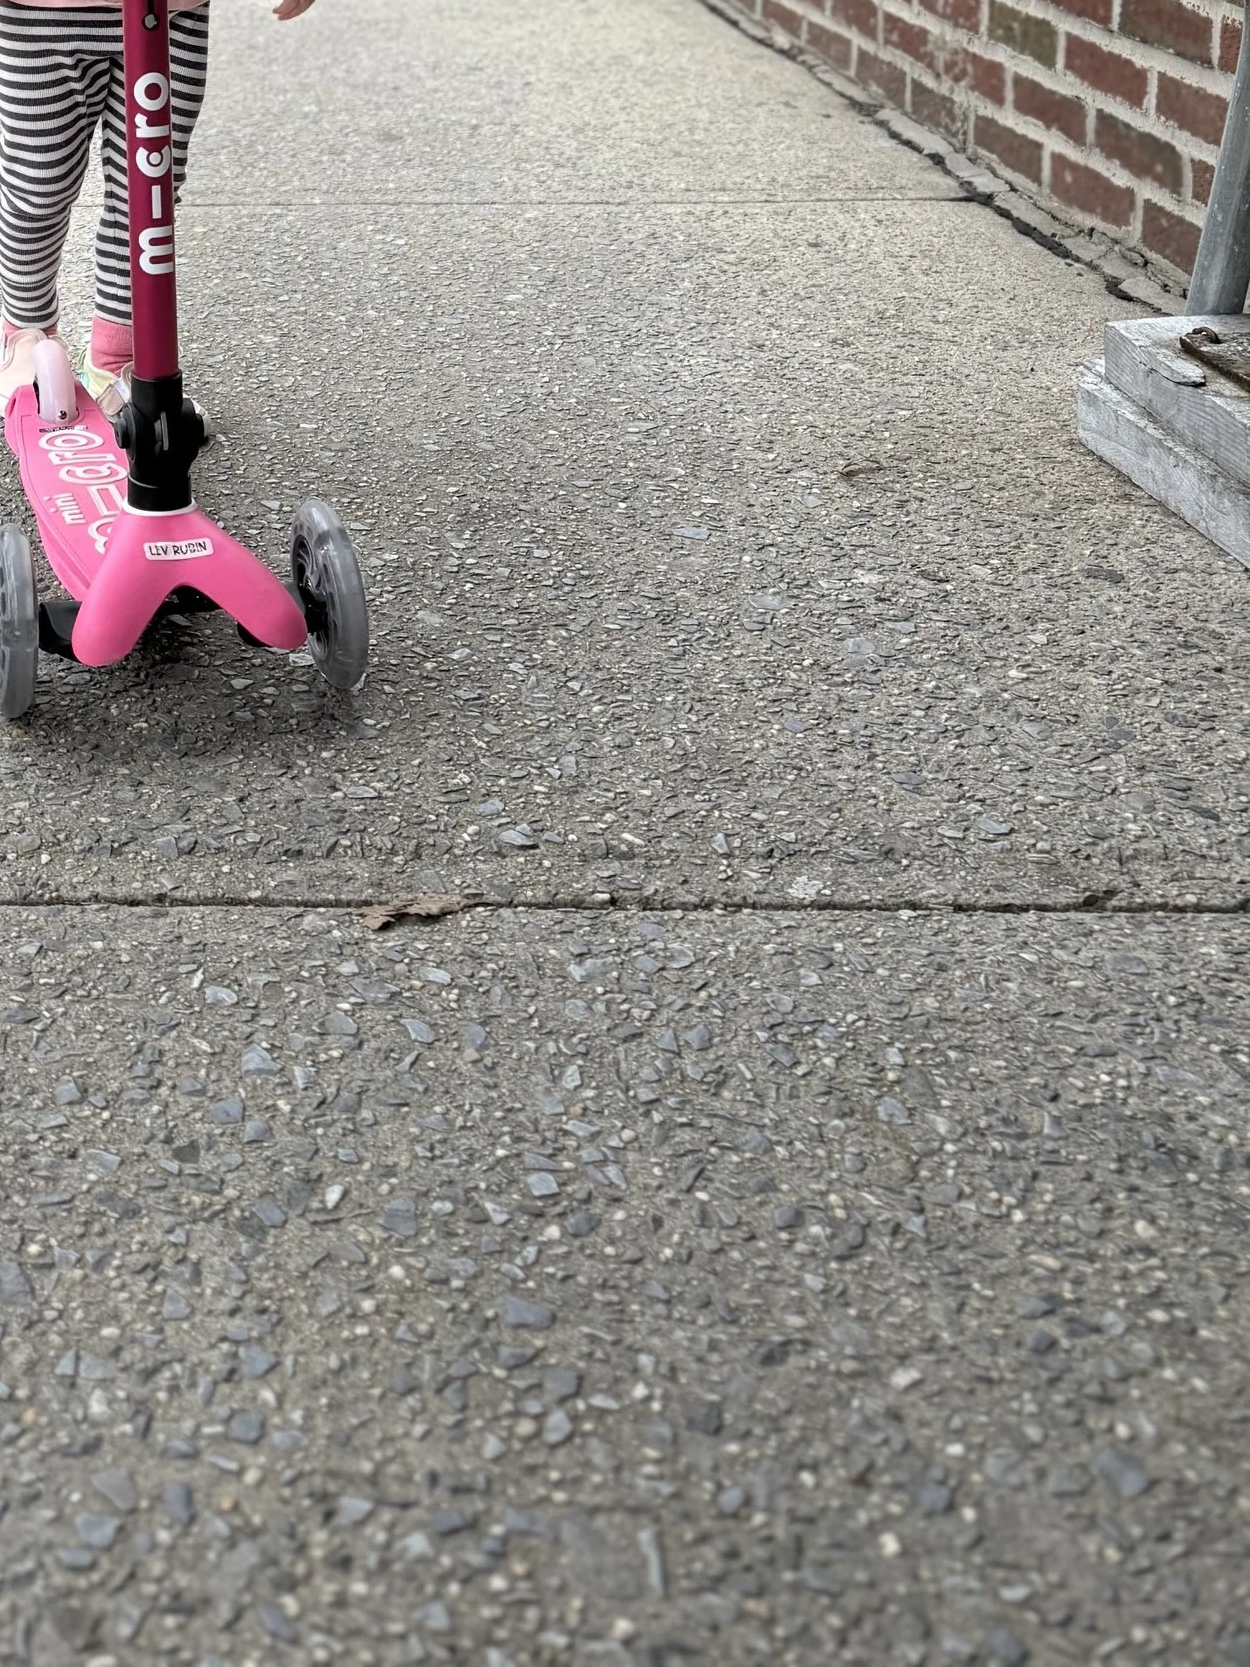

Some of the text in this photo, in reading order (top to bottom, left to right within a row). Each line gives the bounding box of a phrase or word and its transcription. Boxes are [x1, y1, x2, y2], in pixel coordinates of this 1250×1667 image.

[43, 492, 86, 525] mini
[148, 541, 207, 556] LEV RUBIN
